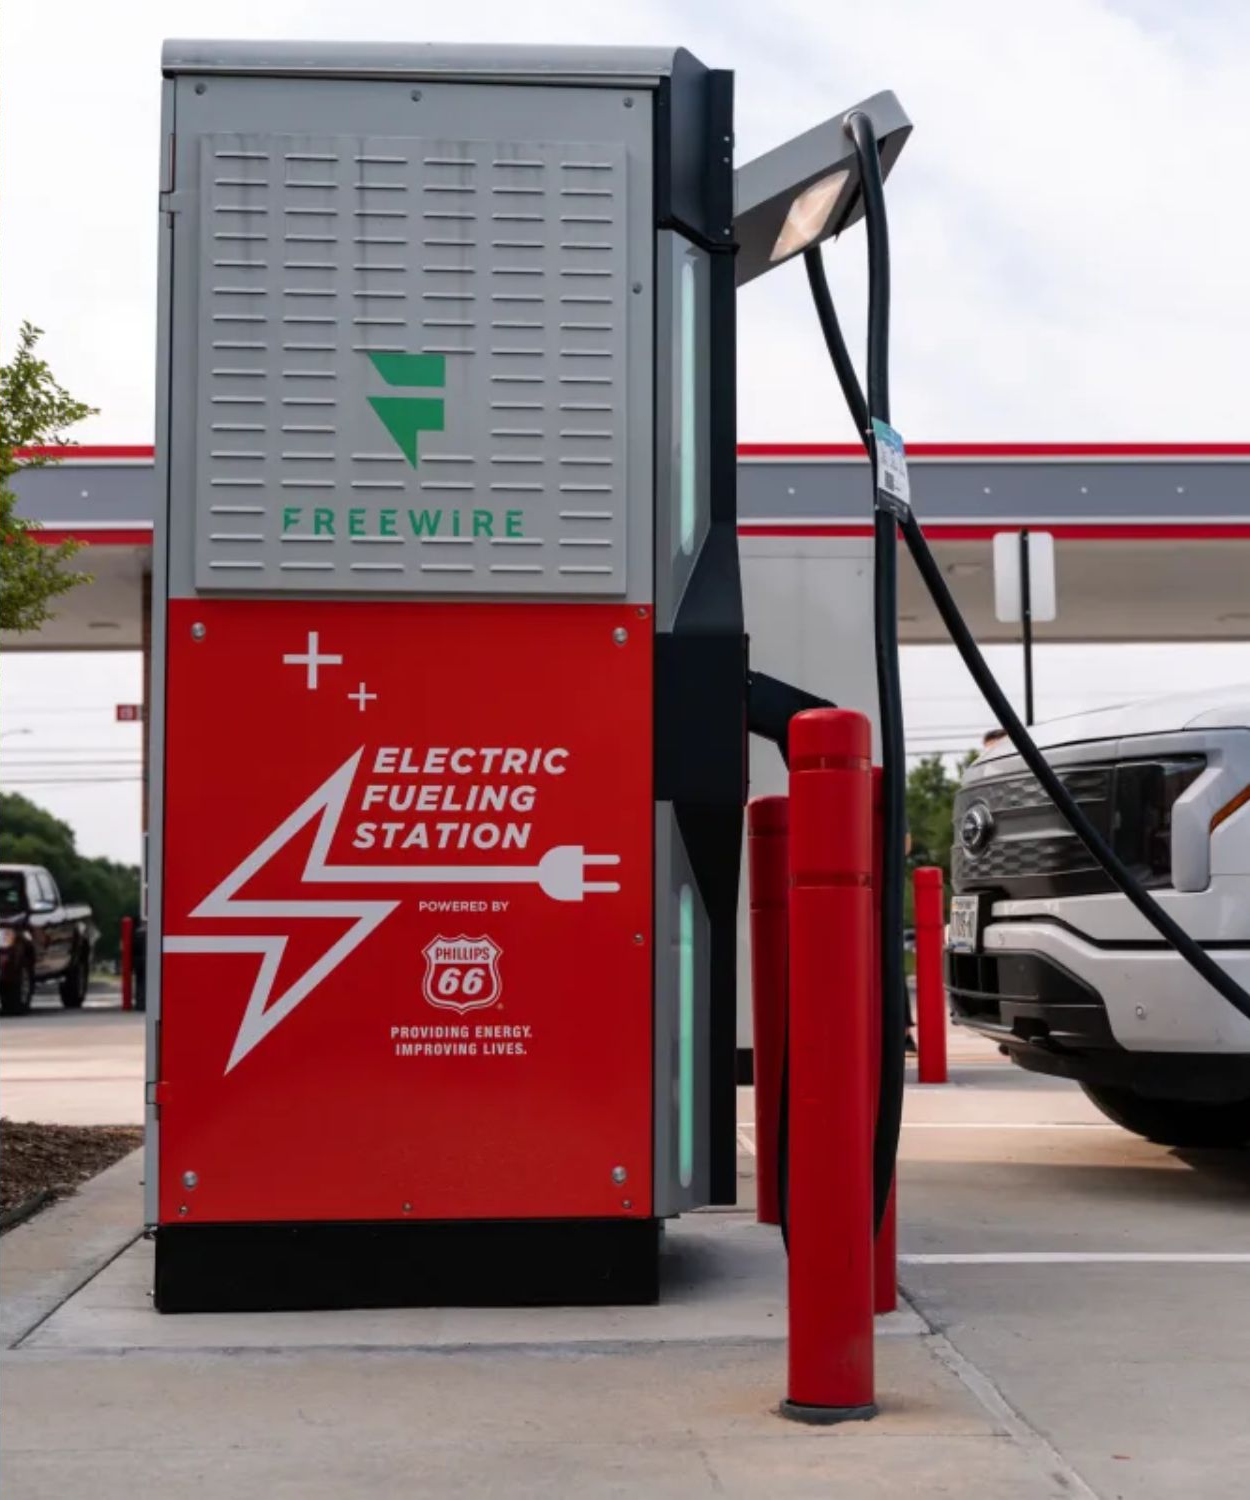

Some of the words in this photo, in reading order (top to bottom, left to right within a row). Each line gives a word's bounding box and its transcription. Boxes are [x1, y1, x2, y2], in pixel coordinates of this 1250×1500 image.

[372, 746, 570, 775] ELECTRIC
[361, 784, 537, 812] FUELING
[352, 821, 532, 849] STATION
[418, 900, 488, 912] POWERED
[491, 901, 509, 912] BY
[435, 947, 490, 961] PHILLIPS
[437, 967, 485, 996] 66
[390, 1026, 469, 1039] PROVIDING
[475, 1025, 533, 1039] ENERGY.
[395, 1043, 477, 1056] IMPROVING
[483, 1043, 528, 1056] LIVES.
